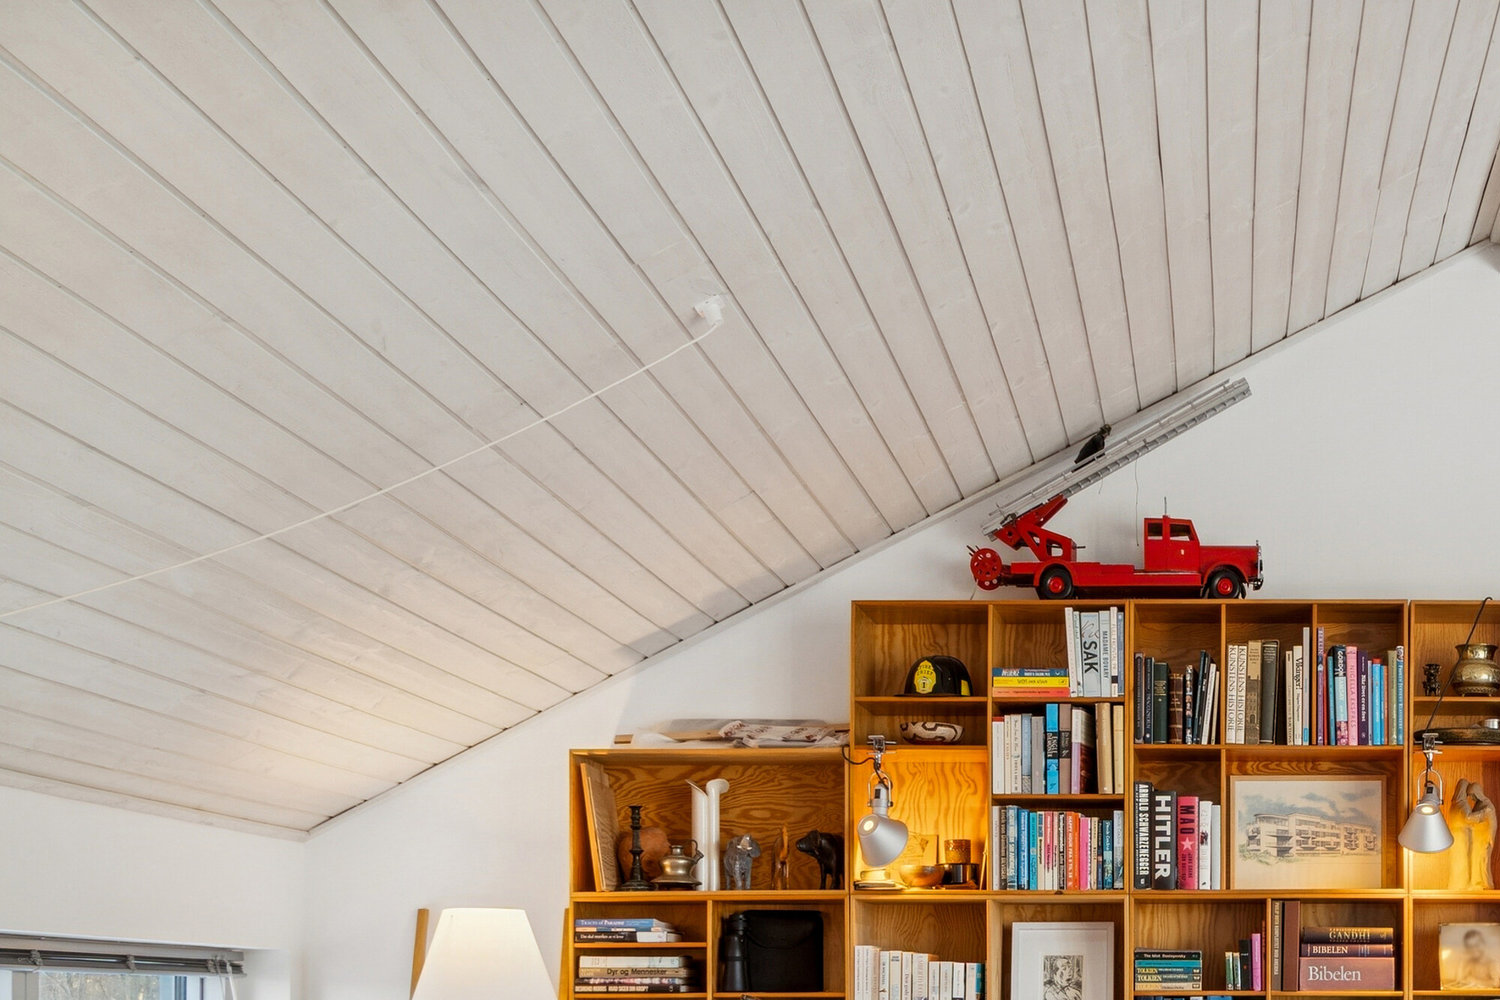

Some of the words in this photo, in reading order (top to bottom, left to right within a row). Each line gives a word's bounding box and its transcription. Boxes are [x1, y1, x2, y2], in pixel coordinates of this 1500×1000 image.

[1083, 640, 1099, 674] SAK
[1228, 646, 1237, 692] KUNSTENS
[1237, 647, 1246, 693] KUNSTENS
[1293, 657, 1303, 690] Vikinger!
[1228, 694, 1237, 732] HISTORIE
[1237, 695, 1246, 732] HISTORIE
[1138, 783, 1149, 811] ARNOLD
[1179, 805, 1195, 835] MAO
[1138, 812, 1149, 876] SCHWARZENEGGER
[1154, 795, 1171, 880] HITLER
[1312, 945, 1348, 955] BIBELEN
[1329, 931, 1371, 940] GANDHI
[1308, 965, 1361, 982] Bibelen
